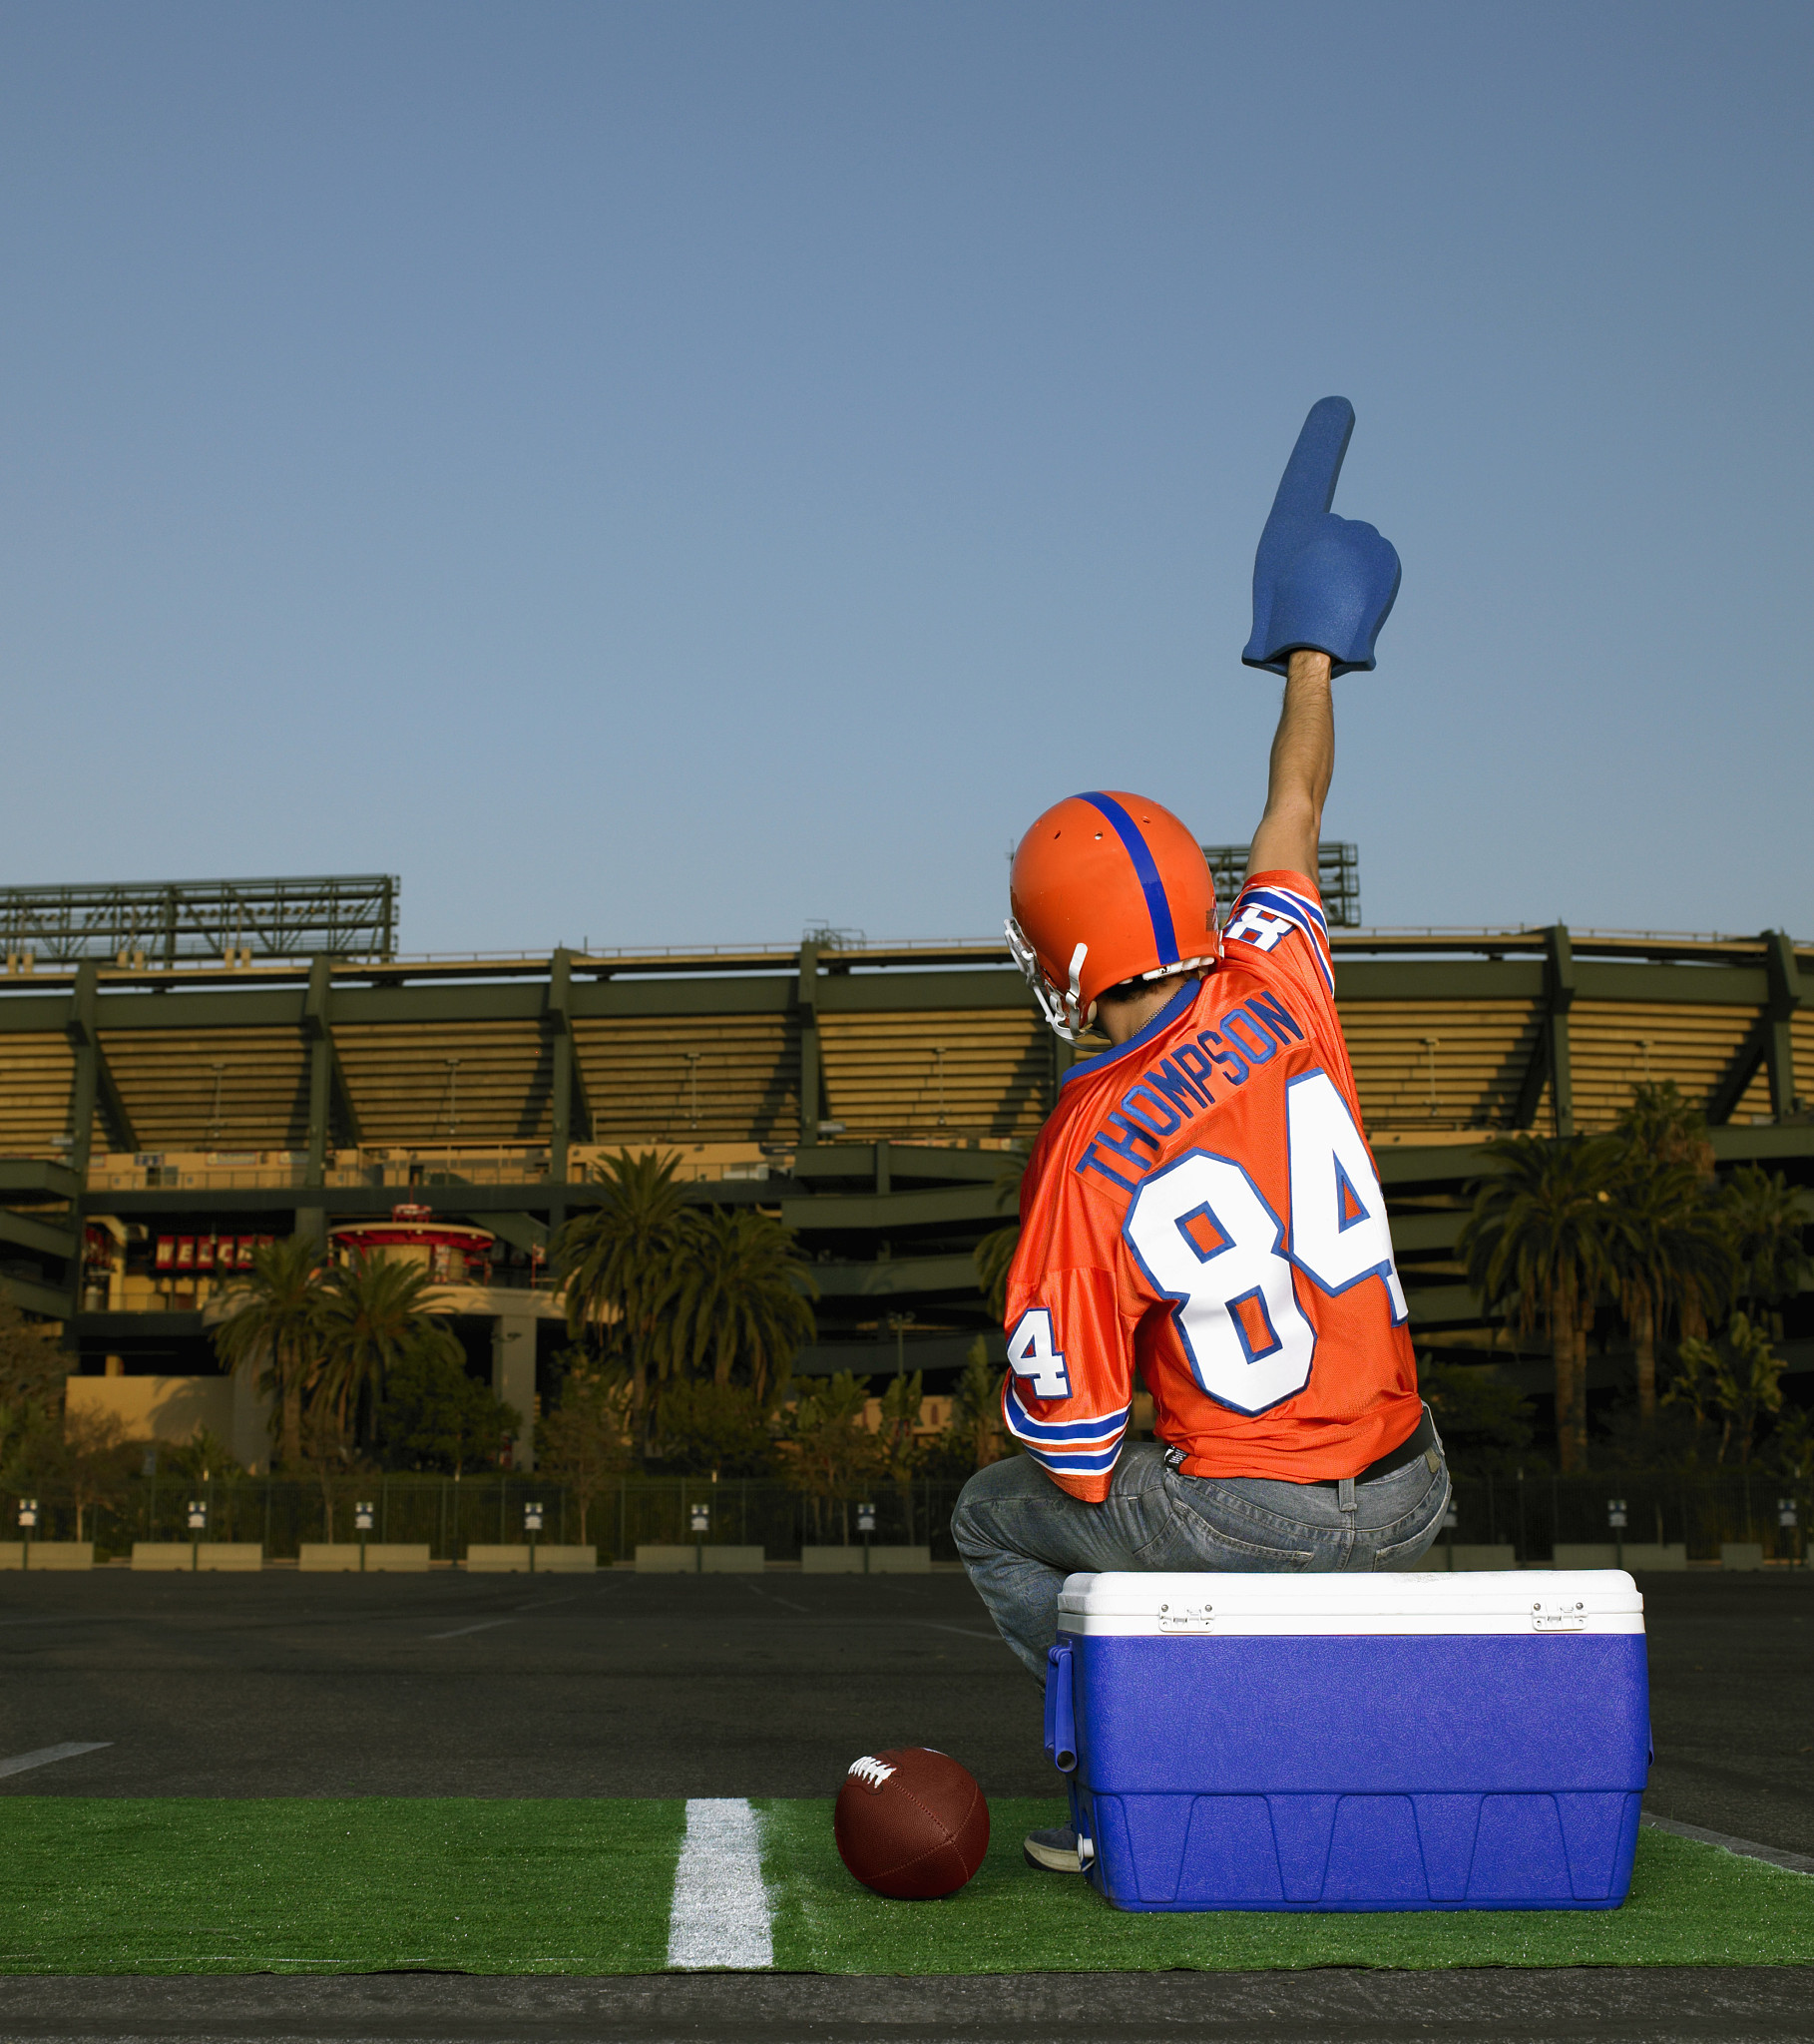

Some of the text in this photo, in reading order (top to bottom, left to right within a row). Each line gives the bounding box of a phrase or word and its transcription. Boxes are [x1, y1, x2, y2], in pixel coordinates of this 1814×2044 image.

[1223, 907, 1298, 953] 8
[1075, 990, 1305, 1195] THOMPSON
[1123, 1067, 1408, 1417] 84
[1006, 1307, 1073, 1399] 4
